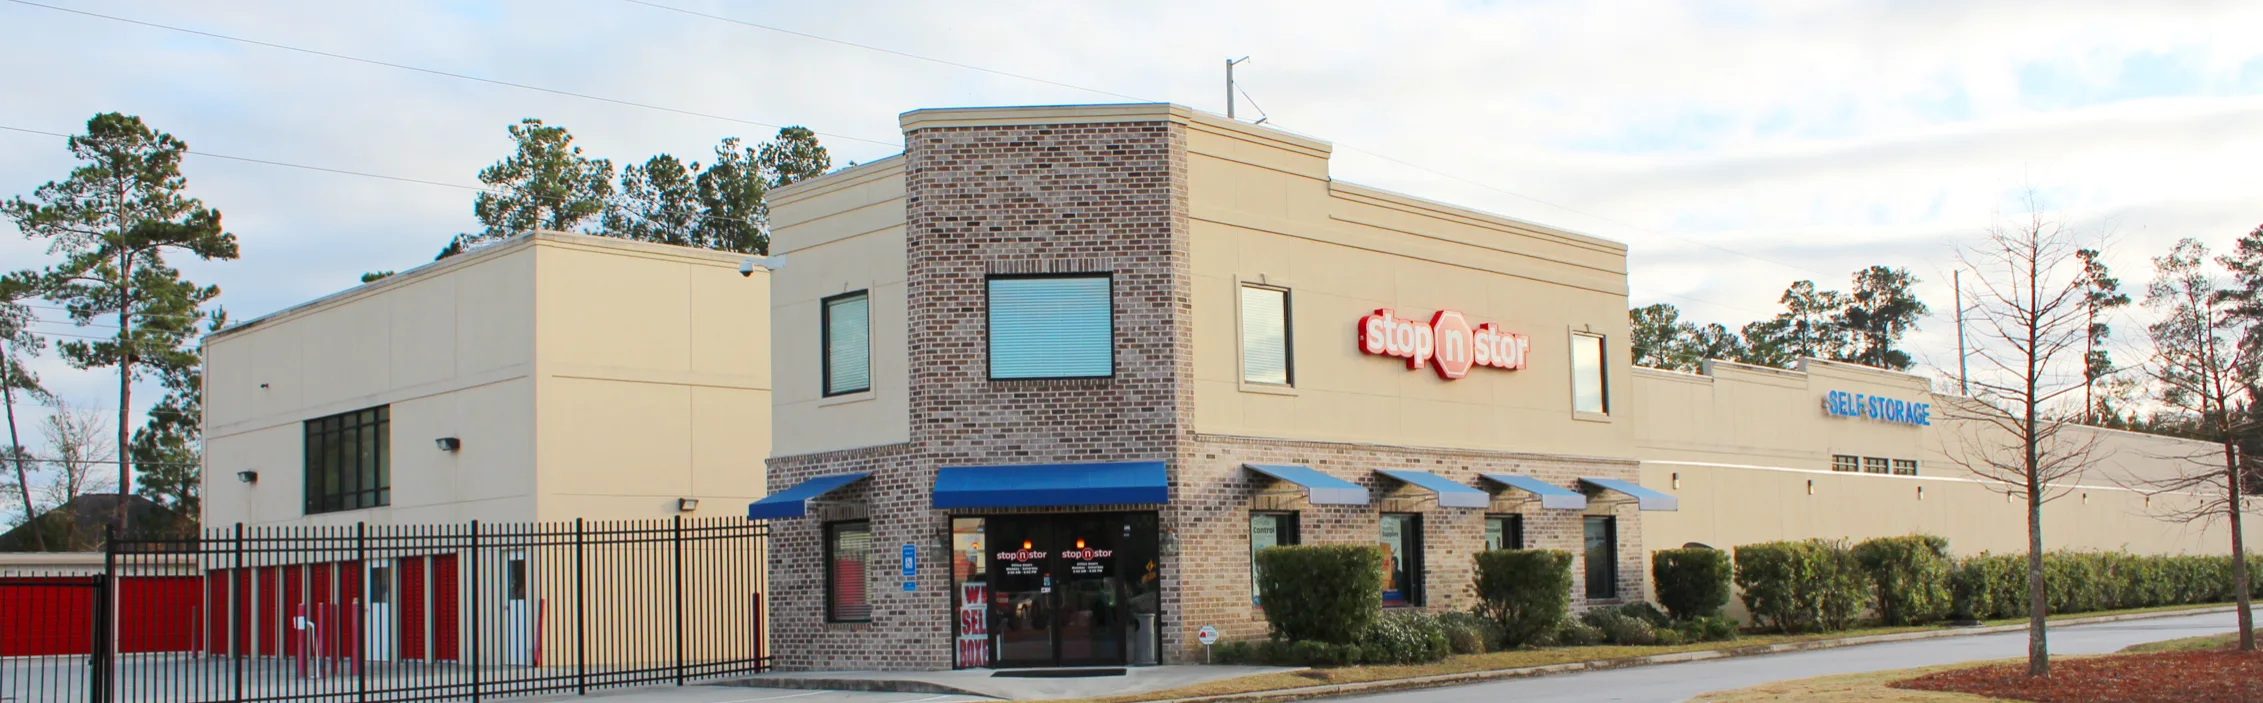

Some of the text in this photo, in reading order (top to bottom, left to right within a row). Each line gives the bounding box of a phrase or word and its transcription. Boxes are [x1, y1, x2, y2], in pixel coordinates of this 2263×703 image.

[1367, 313, 1433, 365] stop
[1474, 324, 1528, 367] stor
[1828, 390, 1931, 426] SELF STORAGE
[1253, 526, 1275, 534] Control
[996, 551, 1017, 560] stop
[1028, 550, 1047, 559] stor
[1062, 550, 1082, 559] stop
[1094, 549, 1113, 557] stor
[962, 609, 987, 635] SEL
[960, 639, 989, 667] BOXE
